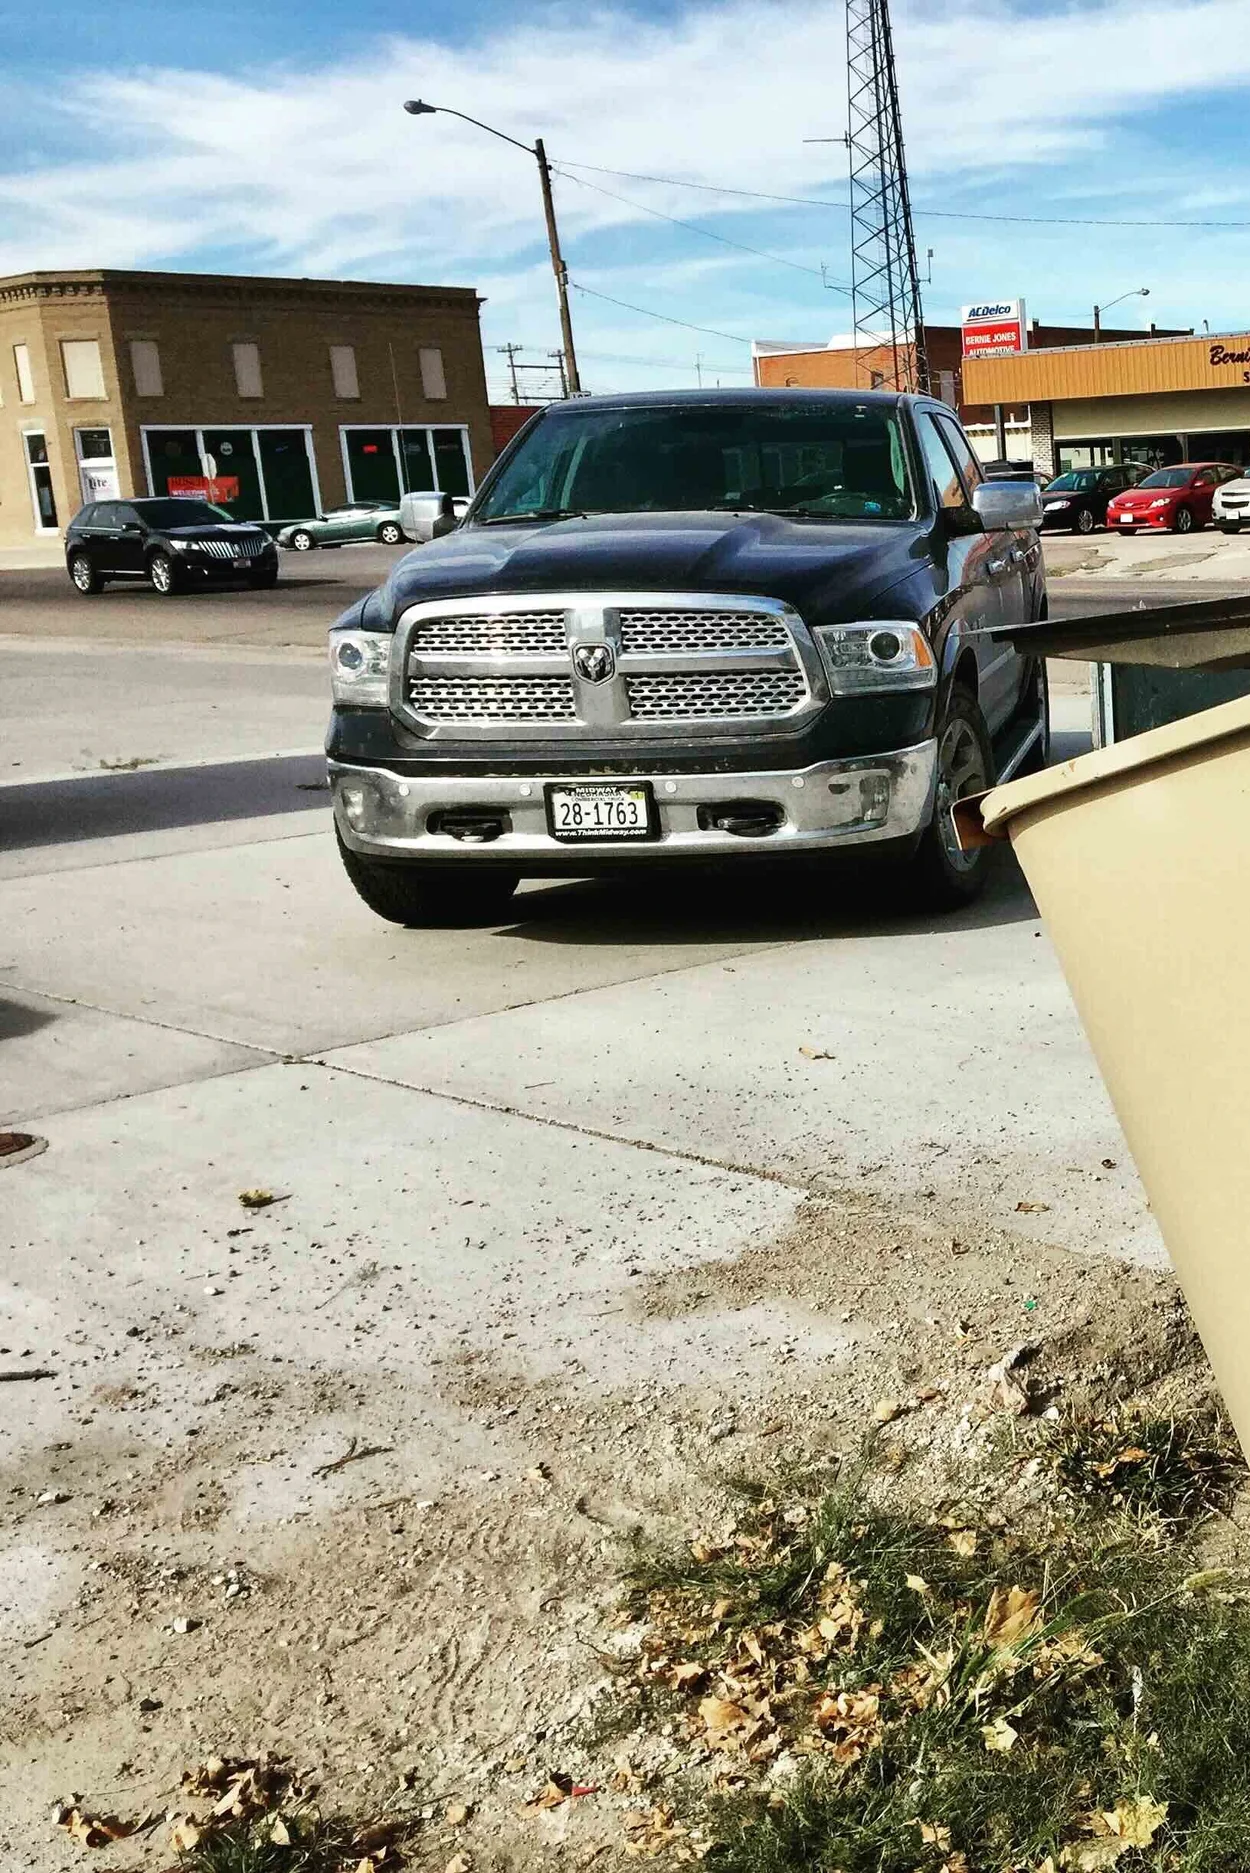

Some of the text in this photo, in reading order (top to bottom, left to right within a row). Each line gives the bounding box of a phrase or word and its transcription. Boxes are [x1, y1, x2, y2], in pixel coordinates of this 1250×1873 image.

[968, 304, 1011, 317] ACDelco
[966, 332, 1016, 345] BERNIE JONES
[560, 801, 639, 826] 28-1763
